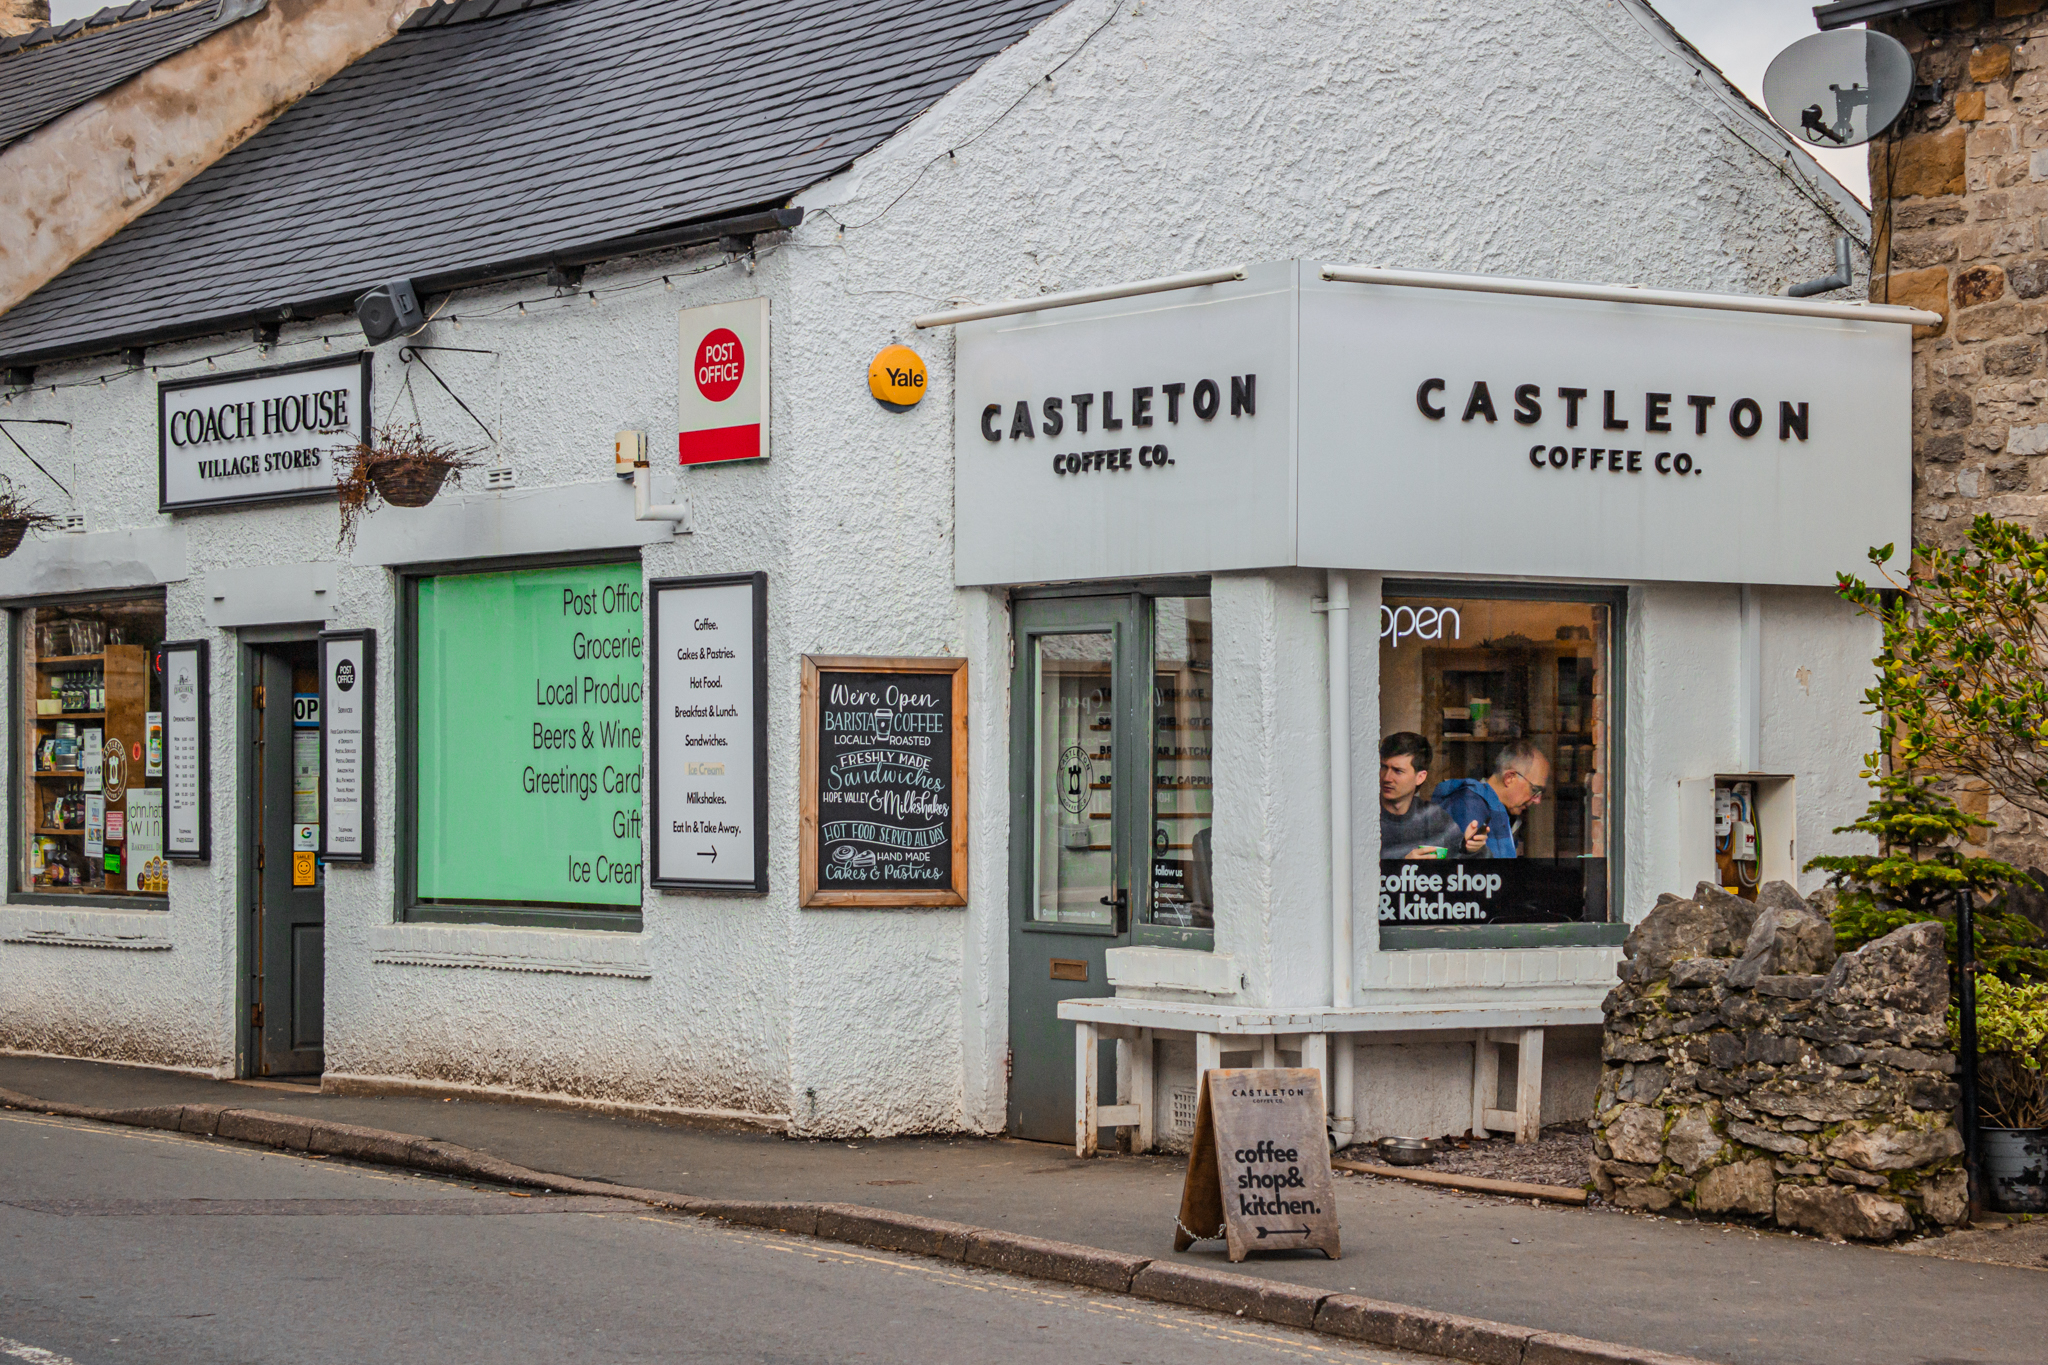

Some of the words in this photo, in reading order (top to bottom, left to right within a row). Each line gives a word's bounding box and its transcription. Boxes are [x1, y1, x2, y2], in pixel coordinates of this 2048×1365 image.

[705, 342, 735, 363] POST
[699, 362, 739, 385] OFFICE
[885, 367, 924, 388] Yale
[170, 401, 255, 447] COACH
[262, 388, 349, 437] HOUSE
[981, 374, 1256, 442] CASTLETON
[1416, 377, 1809, 441] CASTLETON
[198, 454, 260, 479] VILLAGE
[264, 447, 320, 472] STORES
[1053, 448, 1132, 475] COFFEE
[1138, 444, 1175, 468] CO.
[1529, 445, 1642, 473] COFFEE
[1654, 452, 1703, 476] CO.
[563, 588, 597, 616] Post
[602, 583, 643, 614] Offic
[694, 618, 718, 631] Coffee.
[573, 628, 643, 660] Grocerie
[677, 648, 698, 660] Cakes
[699, 647, 705, 659] &
[706, 647, 736, 659] Pastries.
[337, 675, 354, 684] OFFICE
[340, 666, 352, 674] POST
[537, 676, 577, 705] Local
[584, 674, 643, 704] Produc
[690, 677, 702, 689] Hot
[703, 676, 722, 688] Food.
[830, 683, 880, 706] We're
[886, 685, 939, 712] Open
[675, 705, 708, 718] Breakfast
[708, 705, 715, 717] &
[716, 704, 738, 717] Lunch.
[825, 711, 876, 731] BARISTA
[894, 713, 944, 733] COFFEE
[533, 722, 577, 749] Beers
[582, 721, 594, 749] &
[600, 719, 641, 748] Wine
[685, 734, 728, 746] Sandwiches.
[834, 735, 877, 745] LOCALLY
[889, 736, 931, 746] ROASTED
[840, 751, 895, 768] FRESHLY
[899, 753, 931, 770] MADE
[523, 765, 597, 801] Greetings
[603, 764, 641, 793] Card
[828, 761, 945, 792] Sandwiches
[1178, 776, 1212, 784] CAPPU
[687, 792, 727, 804] Milkshakes.
[823, 792, 842, 803] HOPE
[844, 792, 869, 803] VALLEY
[869, 789, 884, 811] &
[884, 790, 949, 820] Milkshakes
[613, 809, 641, 838] Gift
[673, 821, 684, 833] Eat
[685, 821, 691, 833] In
[693, 821, 699, 833] &
[700, 821, 717, 834] Take
[718, 821, 742, 837] Away.
[824, 823, 847, 841] HOT
[852, 823, 876, 840] FOOD
[879, 827, 912, 846] SERVED
[914, 831, 928, 846] ALL
[929, 826, 946, 844] DAY
[877, 852, 902, 861] HAND
[905, 852, 930, 861] MADE
[568, 855, 591, 882] Ice
[826, 860, 867, 880] Cakes
[870, 865, 880, 880] &
[885, 862, 943, 880] Pastries
[1155, 865, 1175, 876] follow
[1447, 864, 1502, 898] shop
[1379, 893, 1397, 920] &
[1400, 893, 1487, 920] kitchen.
[1232, 1089, 1304, 1097] CASTLETON
[1235, 1140, 1298, 1163] coffee
[1238, 1166, 1306, 1193] shop&
[1240, 1193, 1321, 1216] kitchen.
